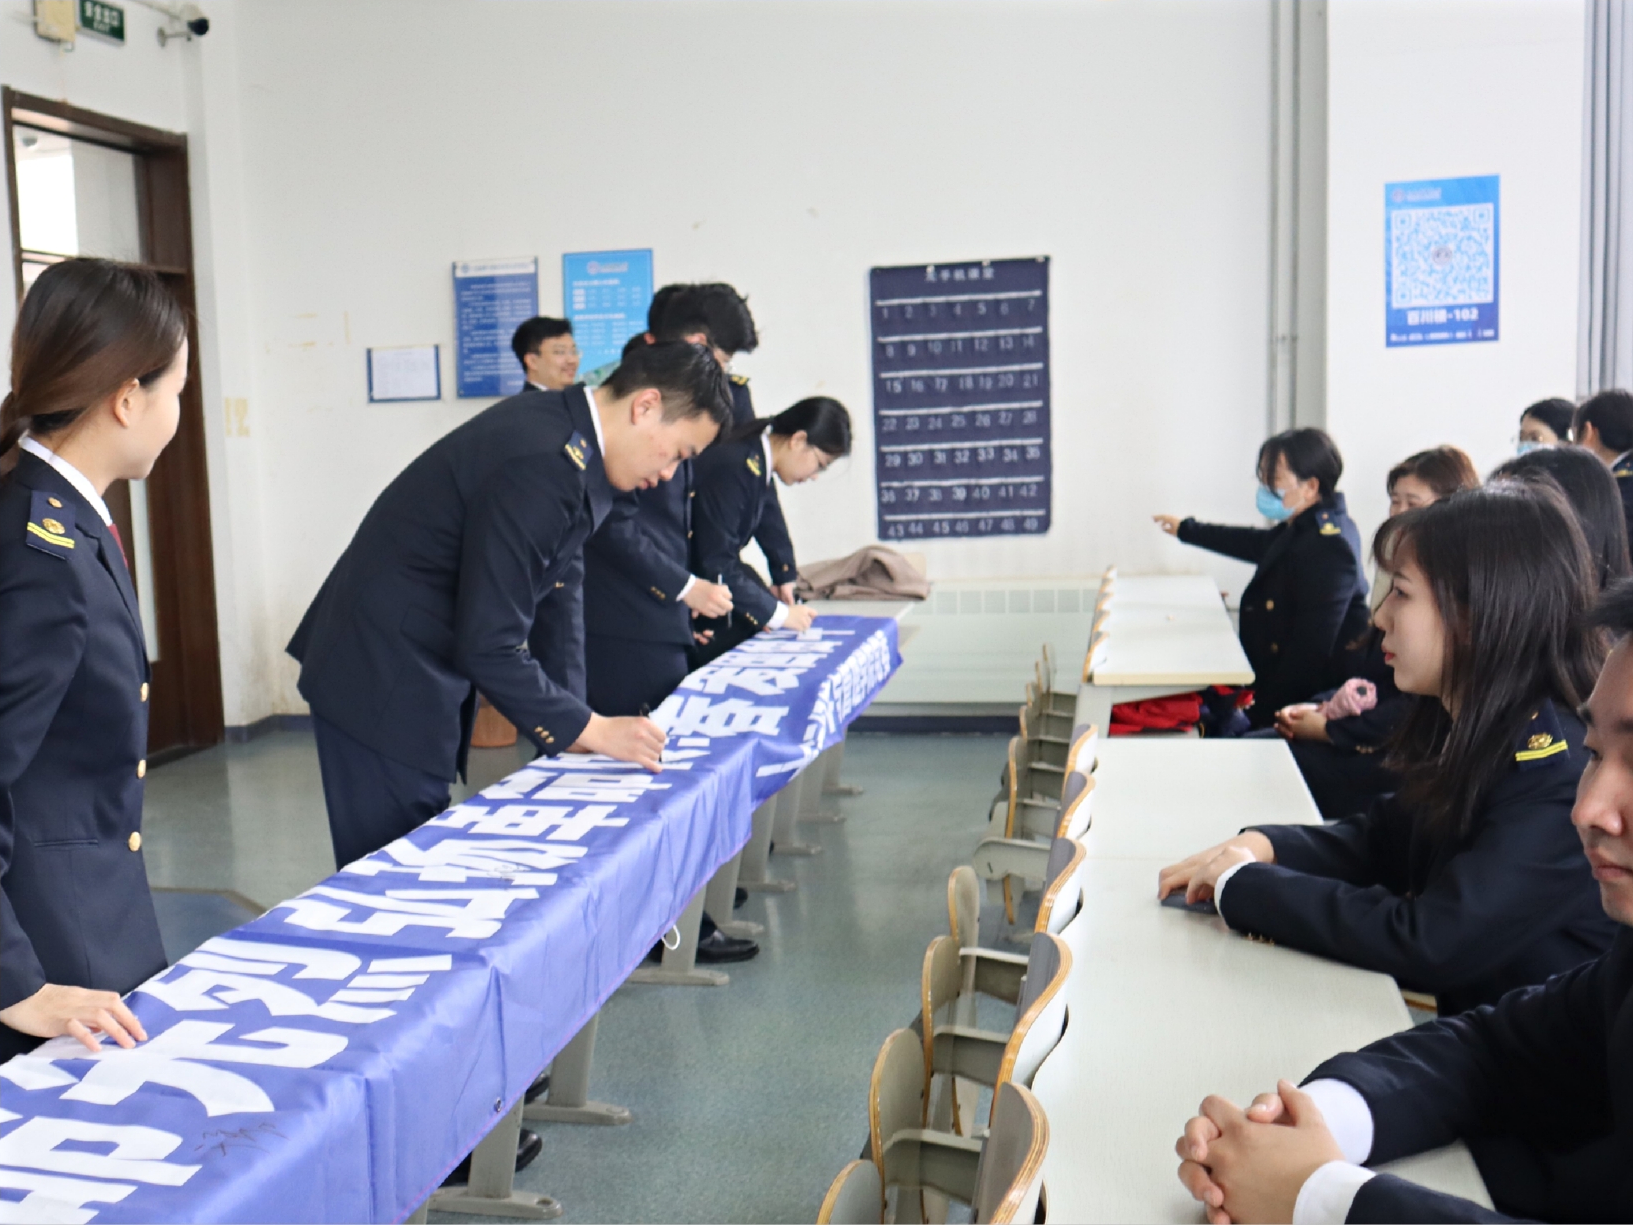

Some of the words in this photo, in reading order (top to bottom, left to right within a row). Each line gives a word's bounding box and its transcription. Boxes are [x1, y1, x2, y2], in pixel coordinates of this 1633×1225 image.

[905, 305, 914, 319] 2
[954, 303, 961, 316] 4
[977, 302, 987, 315] 5
[907, 343, 916, 356] 9
[928, 341, 942, 354] 10
[951, 339, 962, 352] 11
[975, 338, 988, 351] 12
[999, 337, 1013, 350] 13
[886, 379, 902, 393] 15
[911, 379, 924, 393] 16
[959, 376, 974, 390] 18
[979, 376, 992, 390] 19
[998, 374, 1014, 387] 20
[1023, 373, 1039, 389] 21
[882, 418, 897, 433] 22
[905, 417, 920, 430] 23
[928, 417, 942, 430] 24
[951, 415, 966, 428] 25
[975, 414, 991, 427] 26
[998, 411, 1012, 426] 27
[885, 454, 901, 468] 29
[907, 452, 923, 466] 30
[934, 451, 946, 465] 31
[954, 450, 969, 465] 32
[977, 448, 994, 462] 33
[1003, 448, 1017, 463] 34
[1026, 447, 1040, 460] 35
[881, 490, 896, 503] 36
[905, 488, 920, 503] 37
[952, 487, 967, 501] 39
[972, 486, 990, 500] 40
[998, 485, 1013, 499] 41
[1020, 484, 1037, 497] 42
[887, 524, 904, 537] 43
[908, 522, 923, 535] 44
[933, 521, 950, 534] 45
[955, 520, 969, 533] 46
[978, 519, 993, 531] 47
[1024, 517, 1038, 530] 49
